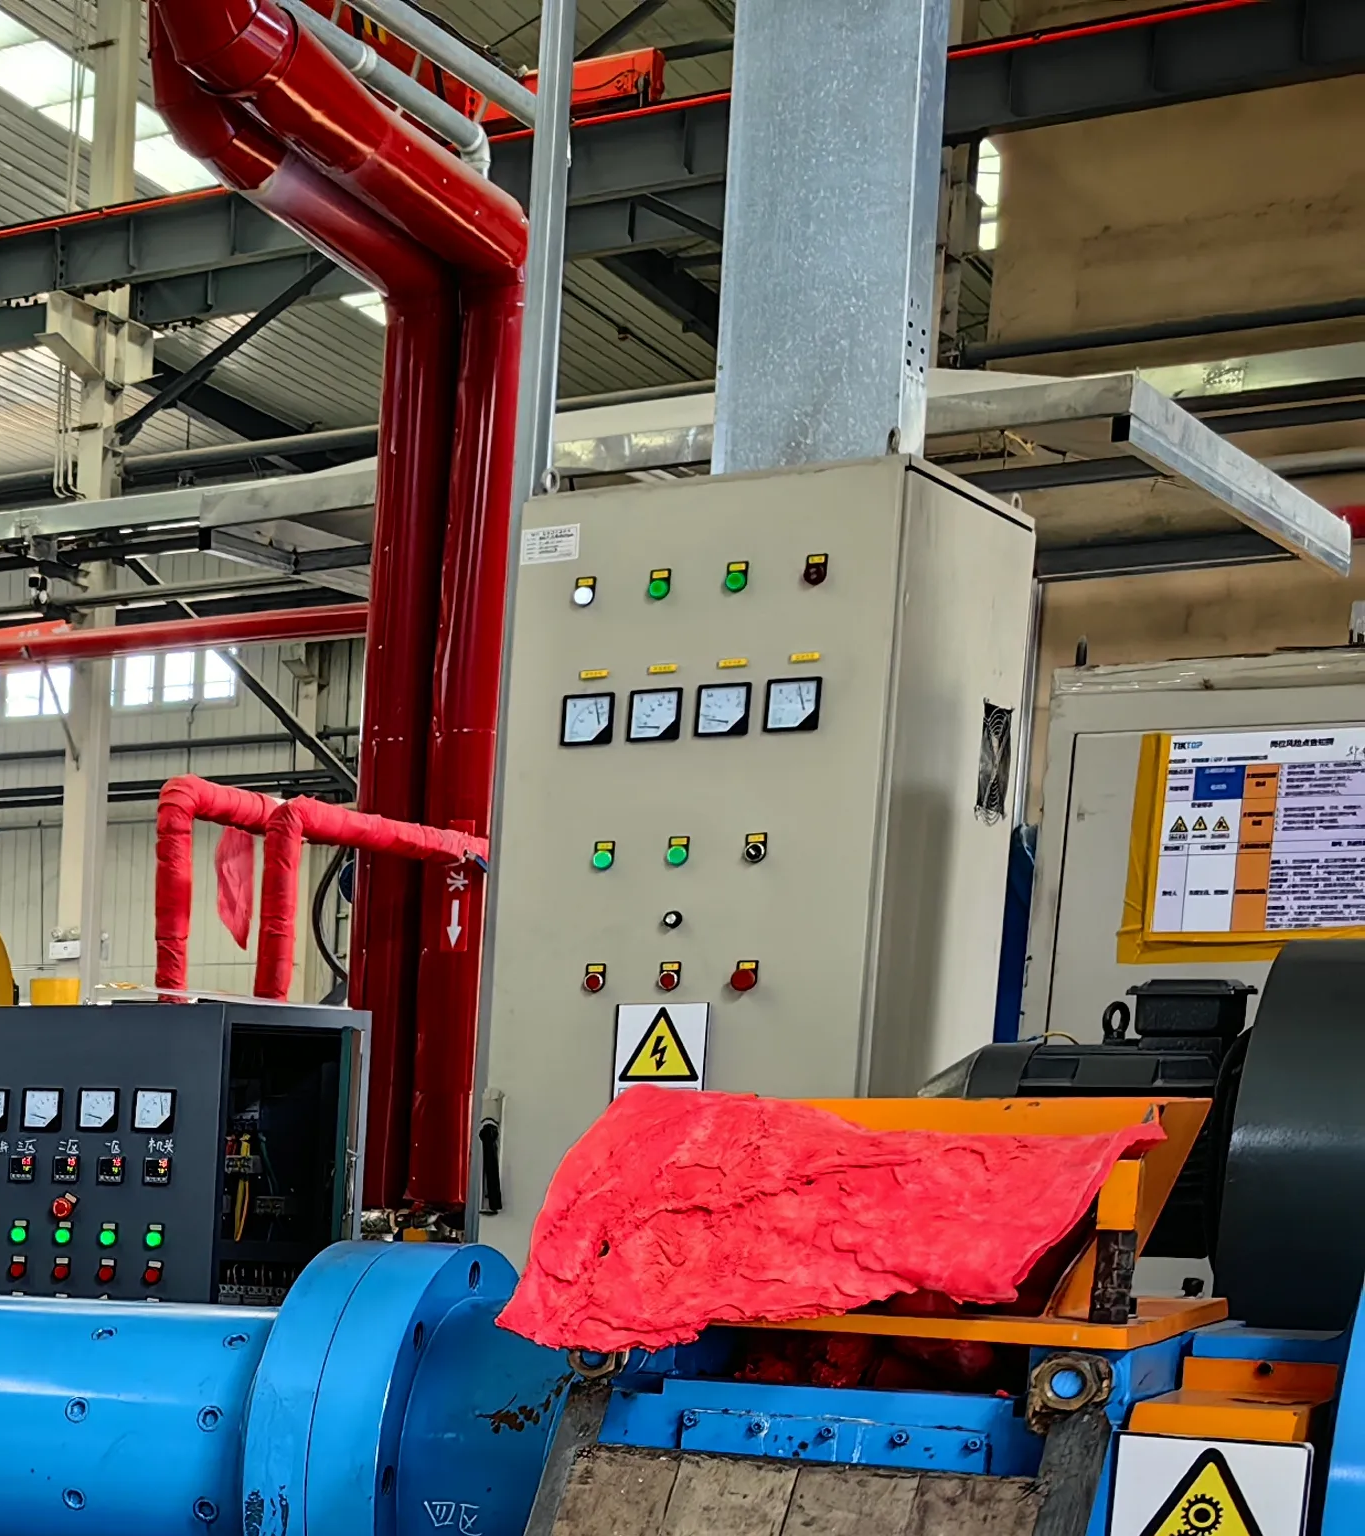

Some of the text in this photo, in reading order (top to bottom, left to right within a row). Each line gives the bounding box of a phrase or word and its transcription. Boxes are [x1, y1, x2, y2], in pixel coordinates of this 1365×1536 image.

[1173, 741, 1203, 750] TIKTOP
[58, 1139, 79, 1154] 二区
[148, 1137, 174, 1154] 机头
[423, 1500, 483, 1536] 四区
